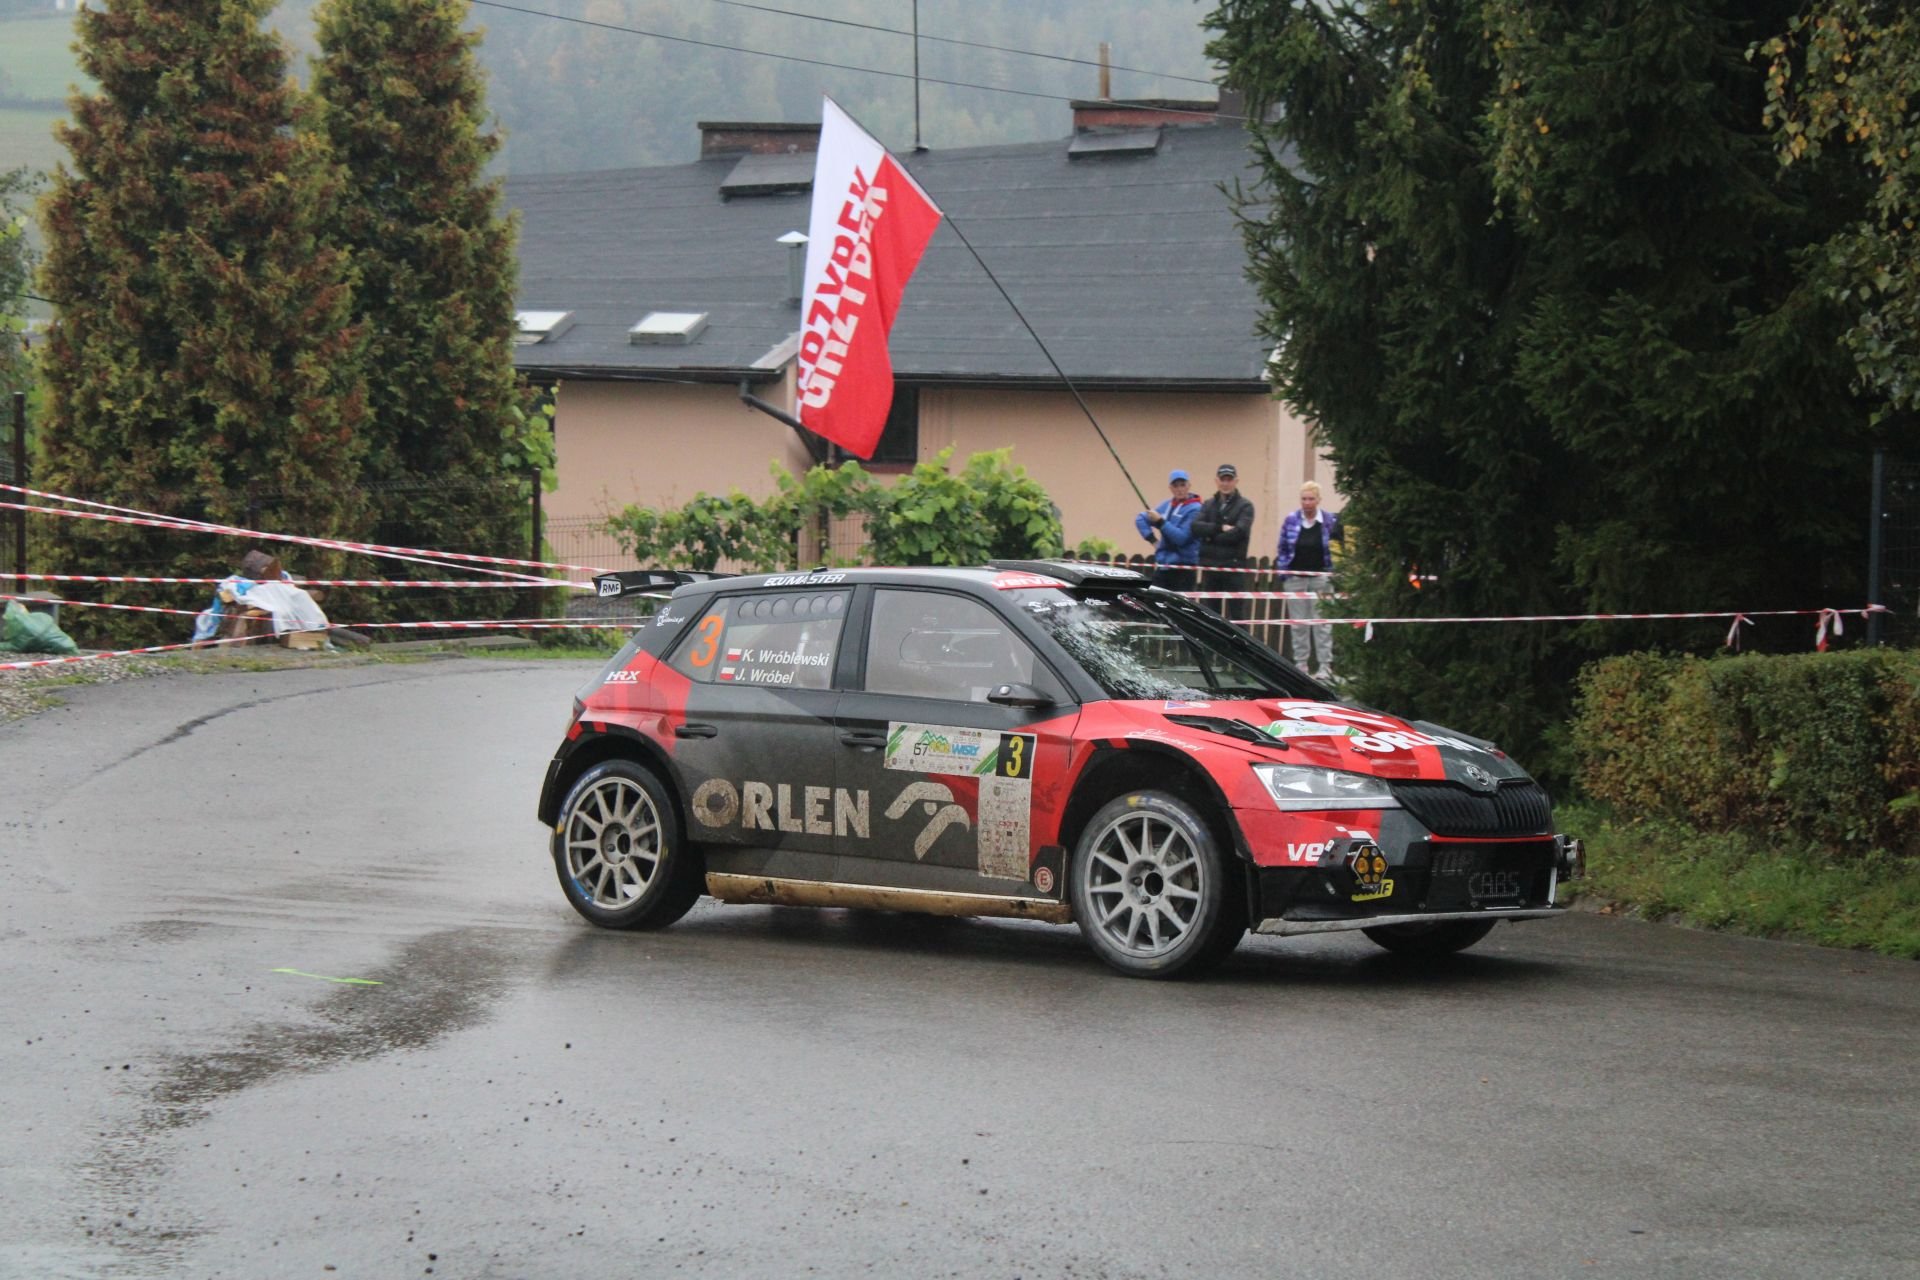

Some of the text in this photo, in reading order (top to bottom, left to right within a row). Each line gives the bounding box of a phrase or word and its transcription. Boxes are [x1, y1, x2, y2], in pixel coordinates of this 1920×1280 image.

[763, 573, 846, 587] ECUMASTER
[602, 583, 619, 594] RMF
[690, 614, 724, 667] 3
[742, 649, 830, 666] K. Wróblewski
[605, 670, 640, 681] HRX
[735, 668, 794, 684] J. Wróbel
[1006, 735, 1024, 777] 3
[692, 778, 870, 838] ORLEN
